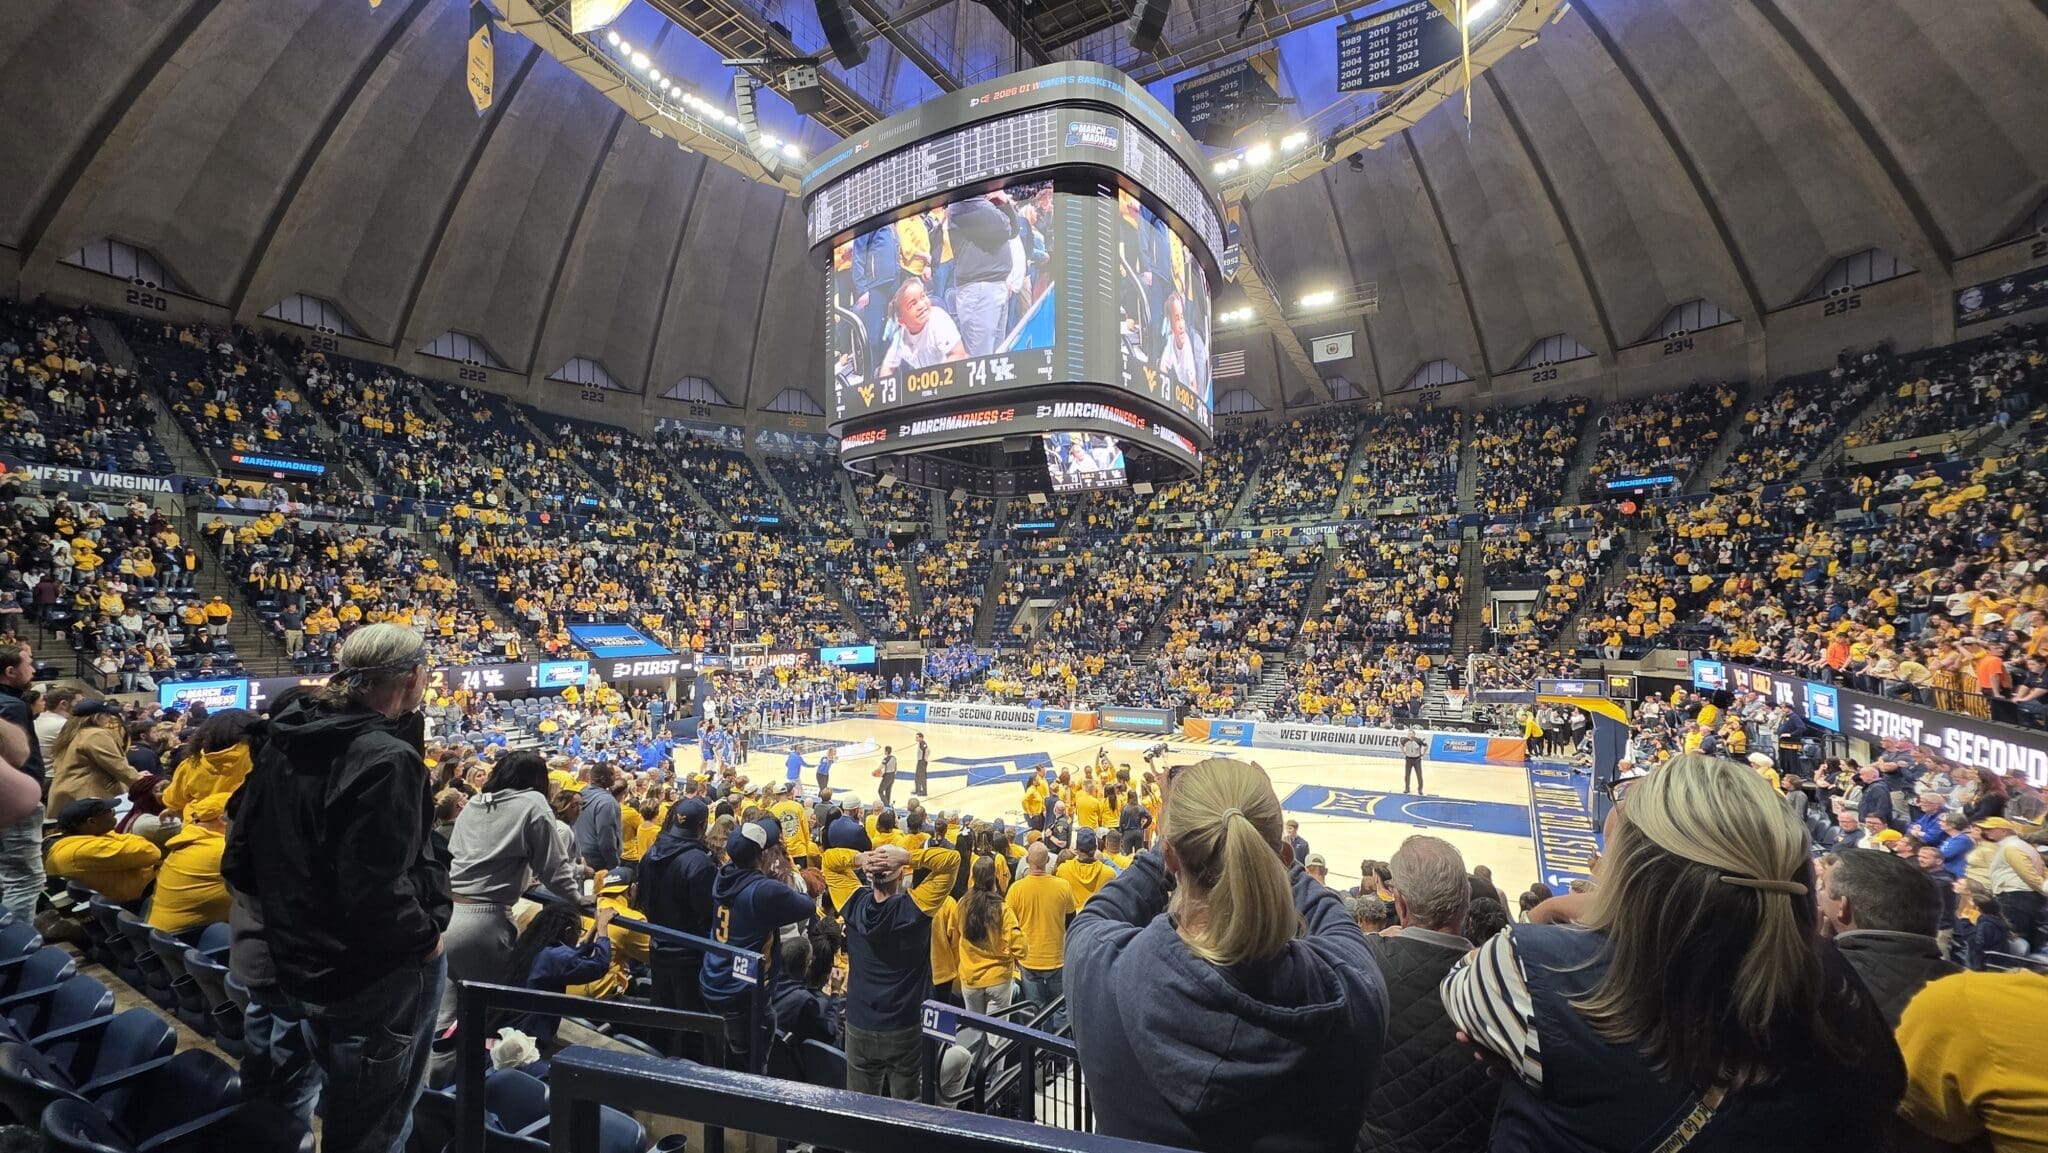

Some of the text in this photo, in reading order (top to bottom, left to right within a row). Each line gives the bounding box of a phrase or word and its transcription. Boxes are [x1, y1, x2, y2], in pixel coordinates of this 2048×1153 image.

[1341, 36, 1362, 48] 1989
[1368, 26, 1390, 39] 2010
[1396, 17, 1419, 30] 2016
[1341, 28, 1419, 58] 1992 2011 2017
[1340, 38, 1419, 69] 2004 2012 2021
[1340, 50, 1419, 80] 2007 2013 2023
[1340, 60, 1420, 90] 2008 2014 2024
[1220, 80, 1239, 92] 2015
[1079, 124, 1106, 136] MARCH
[1082, 134, 1117, 148] MADNESS
[126, 290, 167, 311] 220
[1824, 297, 1862, 317] 235
[311, 335, 339, 352] 221
[1664, 338, 1694, 355] 234
[460, 368, 486, 383] 222
[880, 378, 897, 404] 73
[908, 368, 953, 392] 0:00.2
[966, 359, 987, 388] 74
[1532, 369, 1557, 383] 233
[1160, 374, 1171, 401] 73
[1419, 390, 1441, 401] 232
[581, 391, 604, 403] 223
[690, 406, 711, 417] 224
[1054, 402, 1137, 428] MARCHMADNESS
[911, 410, 999, 436] MARCHMADNESS
[1225, 417, 1243, 426] 230
[26, 465, 174, 493] WEST VIRGINIA
[1270, 529, 1285, 537] 122
[633, 660, 680, 677] FIRST
[462, 671, 481, 689] 74
[187, 688, 222, 697] MARCH
[928, 706, 951, 718] FIRST
[959, 708, 992, 720] SECOND
[994, 711, 1035, 723] ROUNDS
[1280, 728, 1308, 741] WEST
[1311, 731, 1356, 745] VIRGINIA
[1359, 734, 1401, 747] UNIVER
[1872, 708, 1924, 746] FIRST
[1943, 728, 2048, 789] SECOND
[733, 956, 749, 975] C2
[924, 1008, 940, 1030] C1
